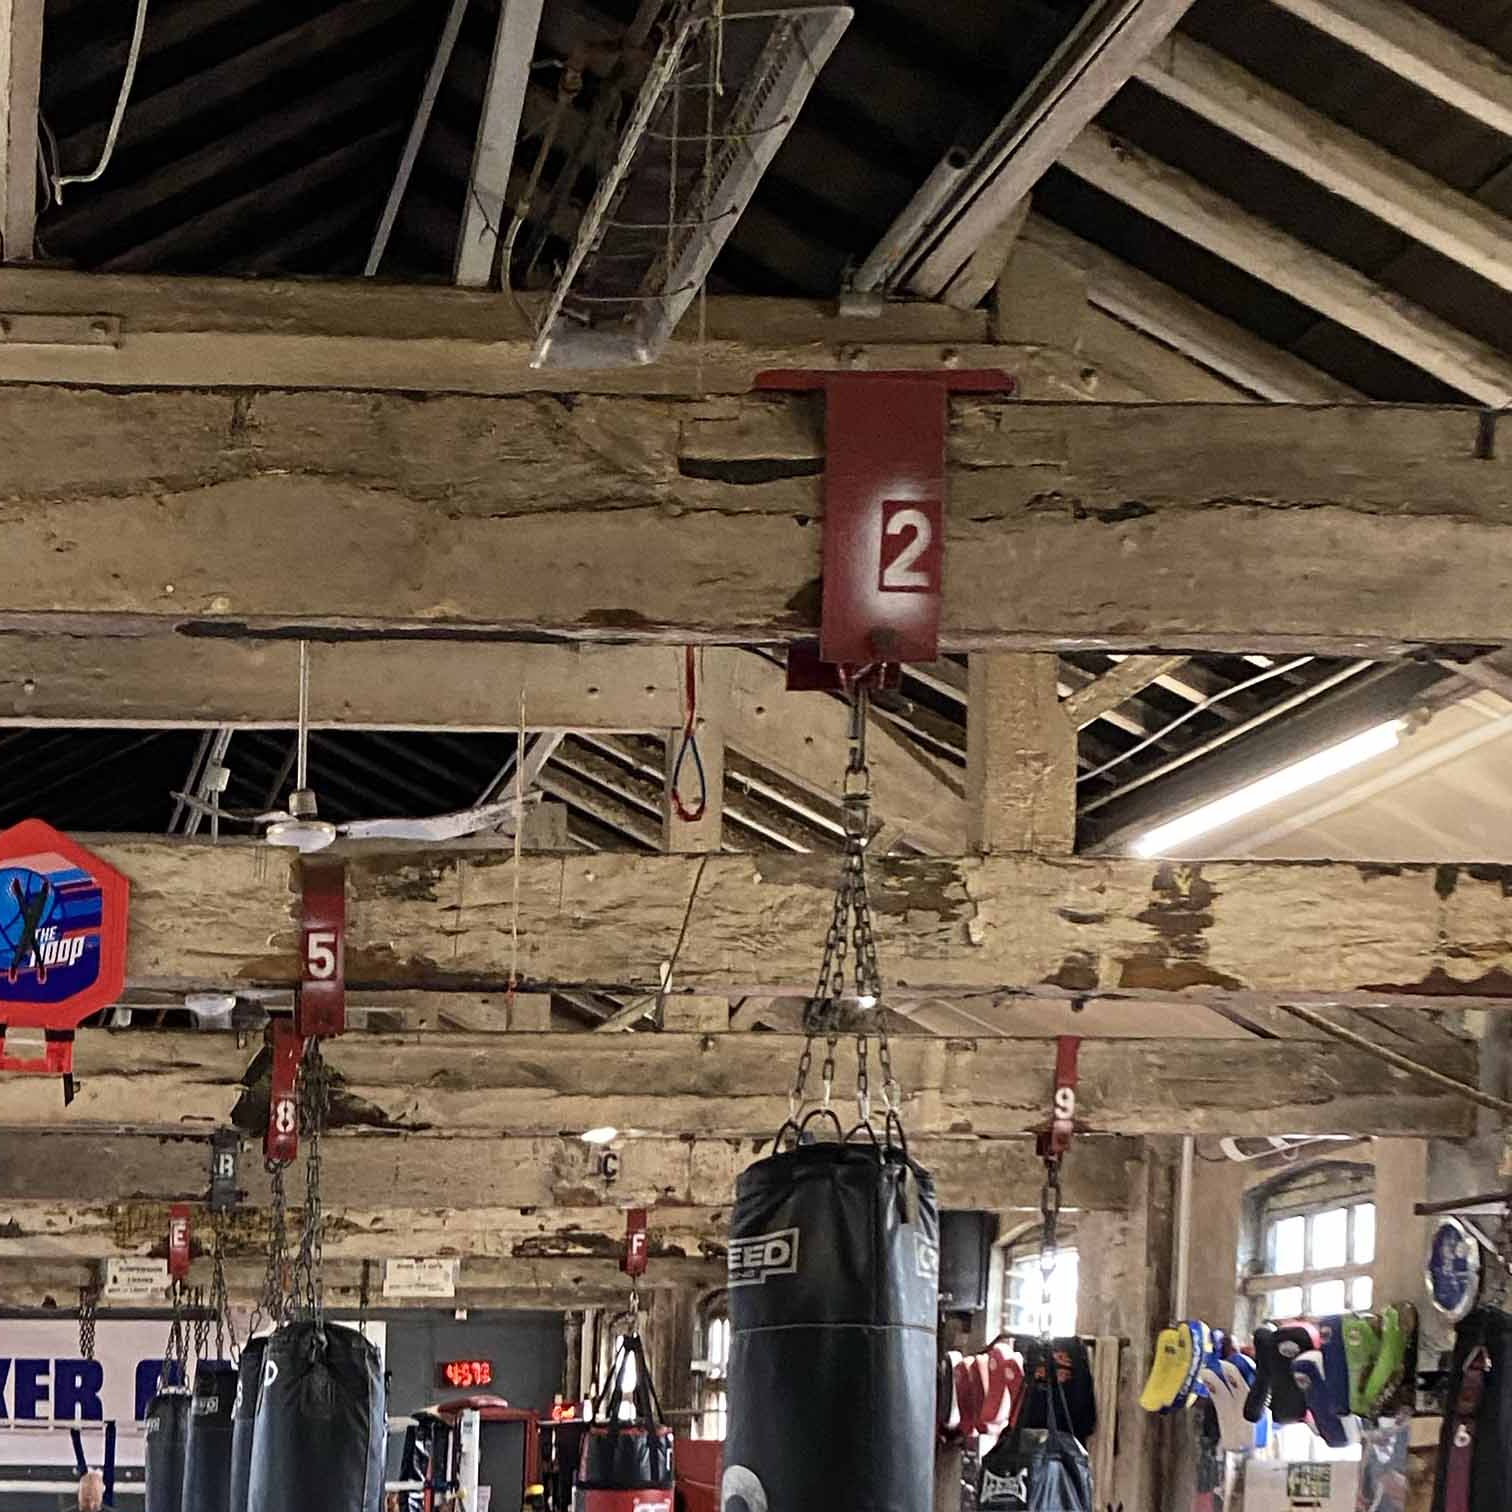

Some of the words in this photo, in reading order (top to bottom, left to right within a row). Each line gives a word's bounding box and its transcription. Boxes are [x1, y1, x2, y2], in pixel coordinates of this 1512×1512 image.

[883, 509, 931, 587] 2
[308, 932, 335, 979] 5
[276, 1100, 296, 1133] 8
[1054, 1087, 1075, 1120] 9
[173, 1220, 187, 1246] E
[632, 1233, 646, 1255] F
